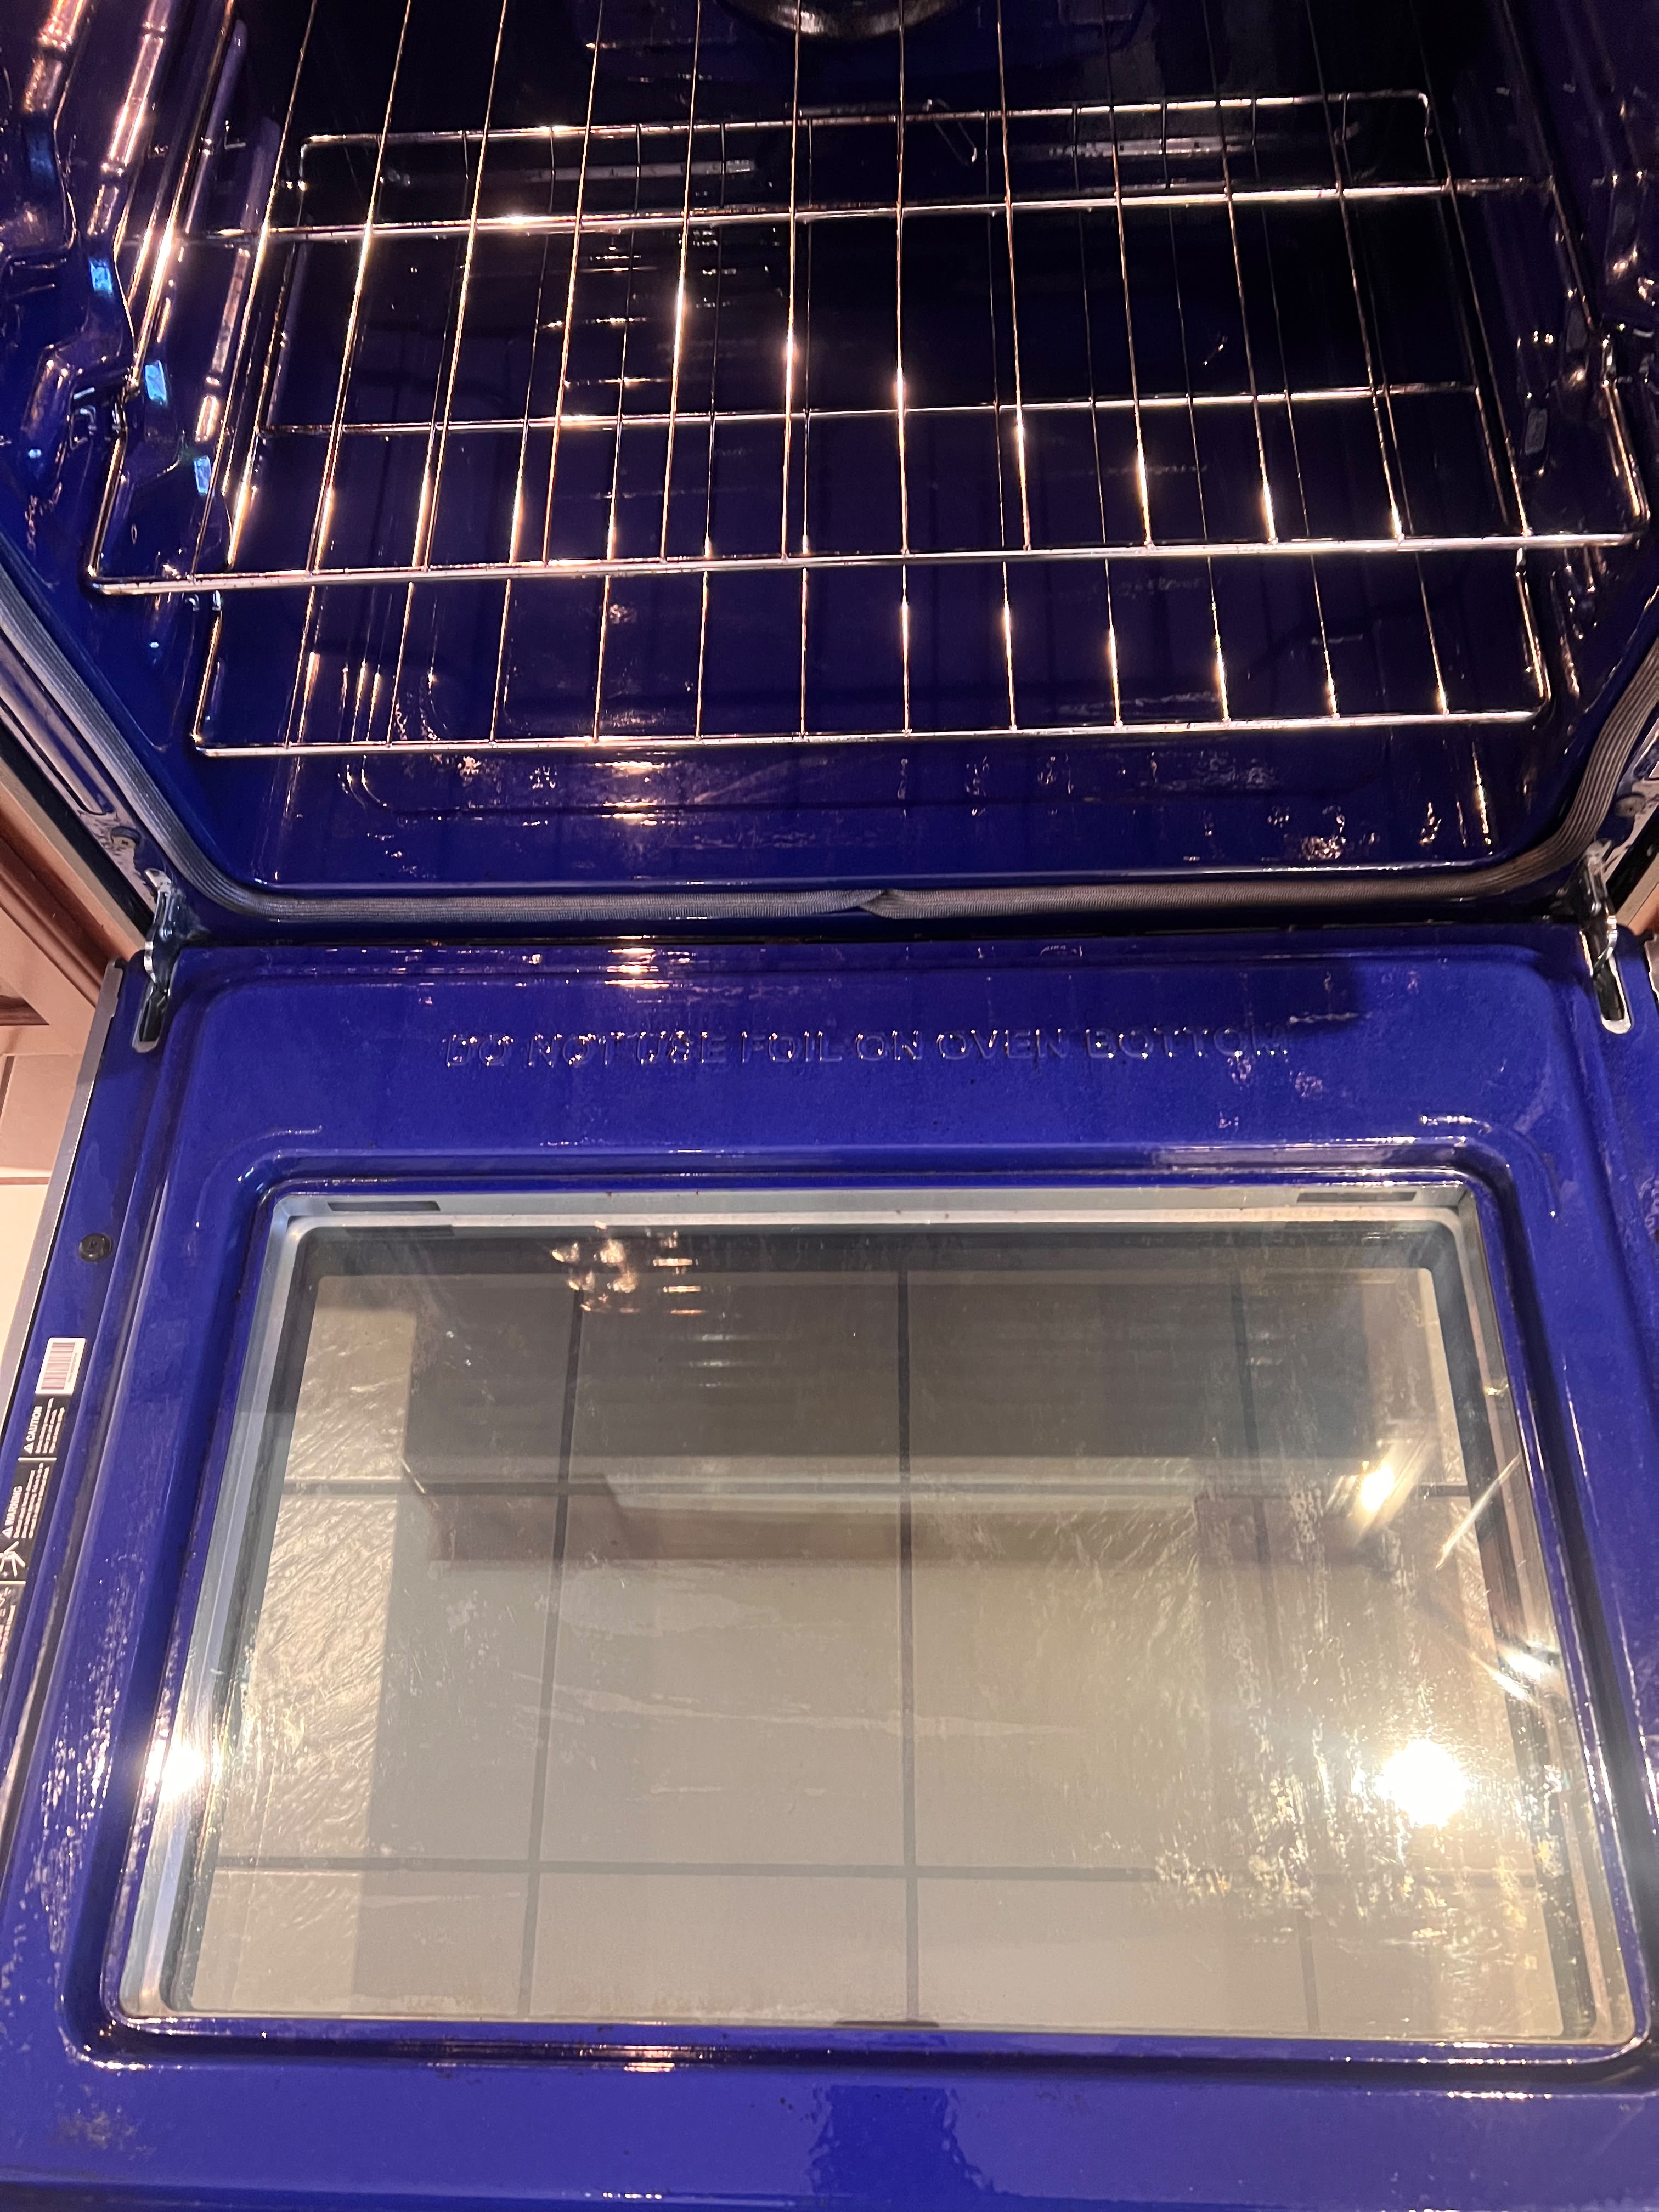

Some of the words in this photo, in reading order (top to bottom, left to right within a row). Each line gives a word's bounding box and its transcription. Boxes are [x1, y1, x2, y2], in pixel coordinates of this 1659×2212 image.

[742, 1031, 843, 1063] FOIL
[854, 1030, 923, 1061] ON
[936, 1029, 1066, 1061] OVEN
[1085, 1025, 1289, 1059] BOTTOM
[26, 1406, 43, 1442] CAUTION
[4, 1486, 22, 1526] WARNING
